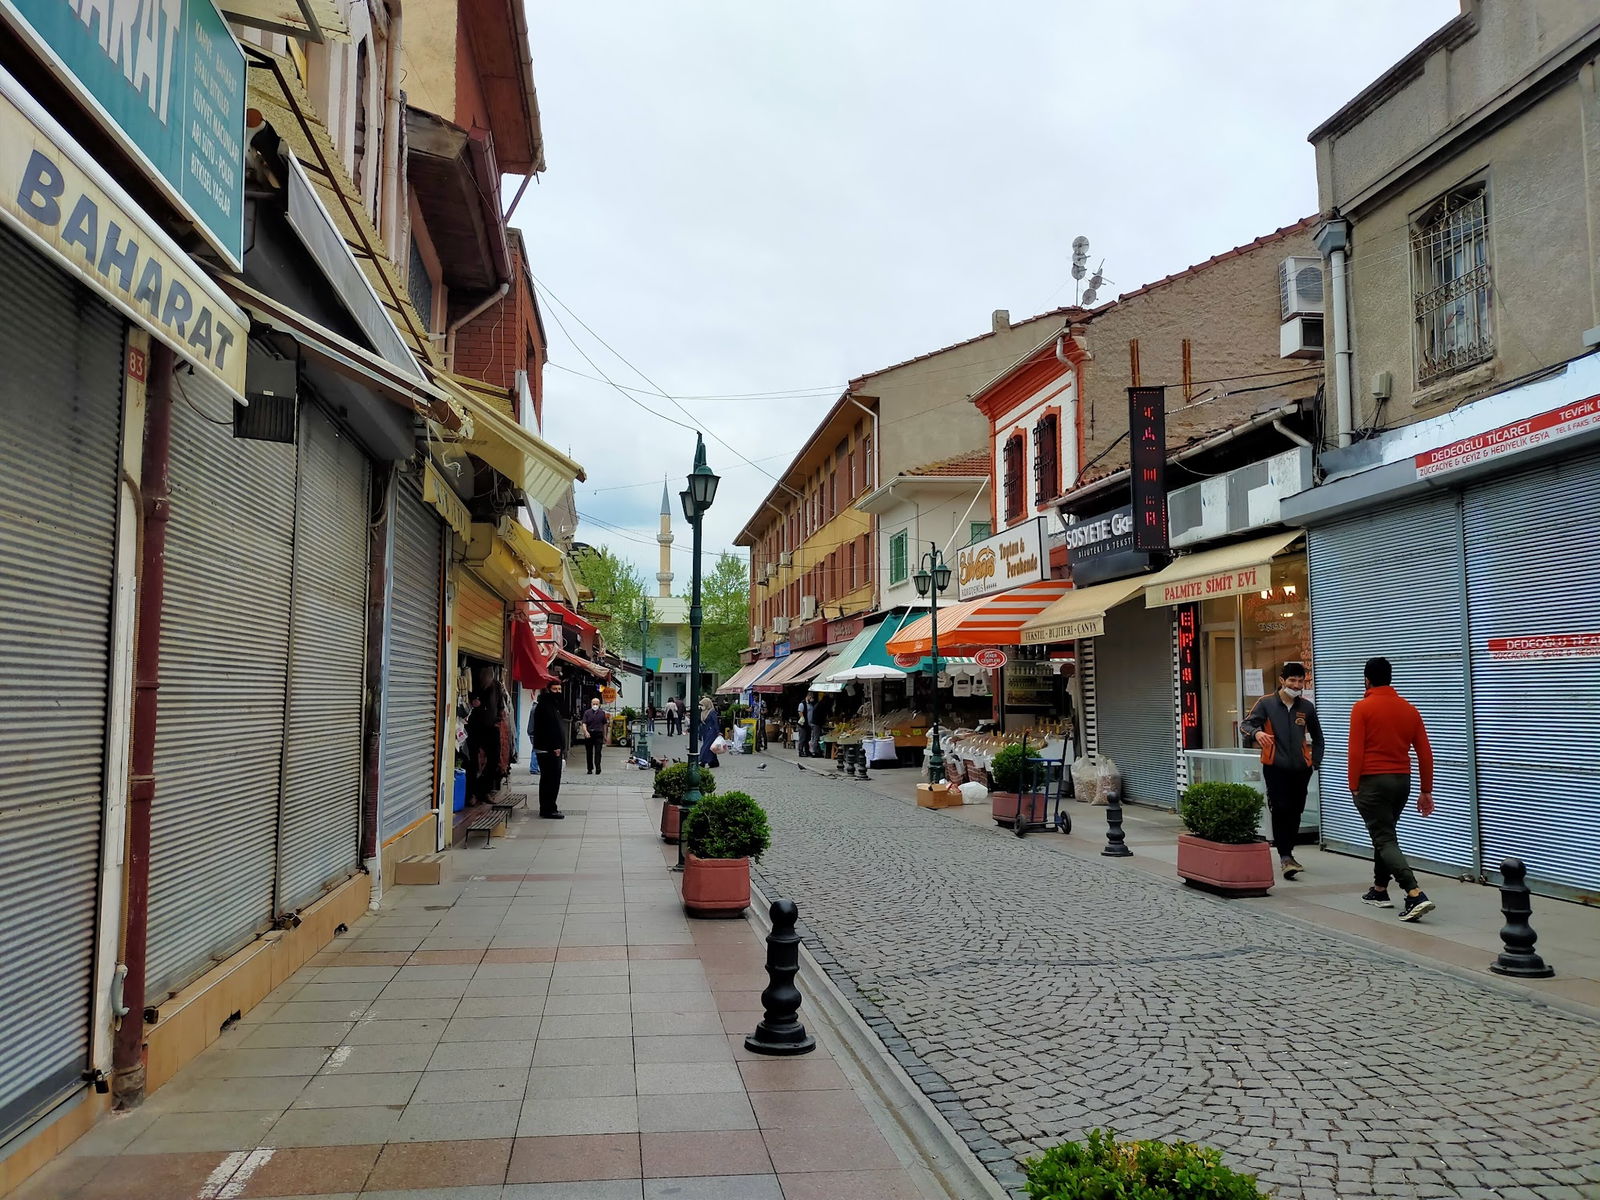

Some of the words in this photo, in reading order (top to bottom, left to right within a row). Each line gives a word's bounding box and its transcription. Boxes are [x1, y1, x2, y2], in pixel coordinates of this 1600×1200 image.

[193, 85, 213, 129] KUVVET
[213, 114, 240, 166] MACUNLARI
[191, 120, 202, 148] ARI
[218, 155, 234, 191] POLEN
[16, 149, 234, 371] BAHARAT
[130, 352, 143, 376] 83
[1419, 460, 1453, 477] ZÜCCACİYE
[1461, 451, 1481, 465] ÇEYİZ
[1491, 440, 1528, 455] HEDİYELİK
[1530, 431, 1550, 444] EŞYA
[1431, 439, 1484, 463] DEDEOĞLU
[1487, 422, 1532, 445] TİCARET
[1559, 402, 1594, 421] TEVFİK
[1066, 519, 1112, 549] SOSYETE
[1164, 581, 1202, 600] PALMİYE
[1206, 574, 1233, 594] SİMİT
[1237, 567, 1256, 588] EVİ
[1506, 637, 1567, 650] DEDEOĞLU
